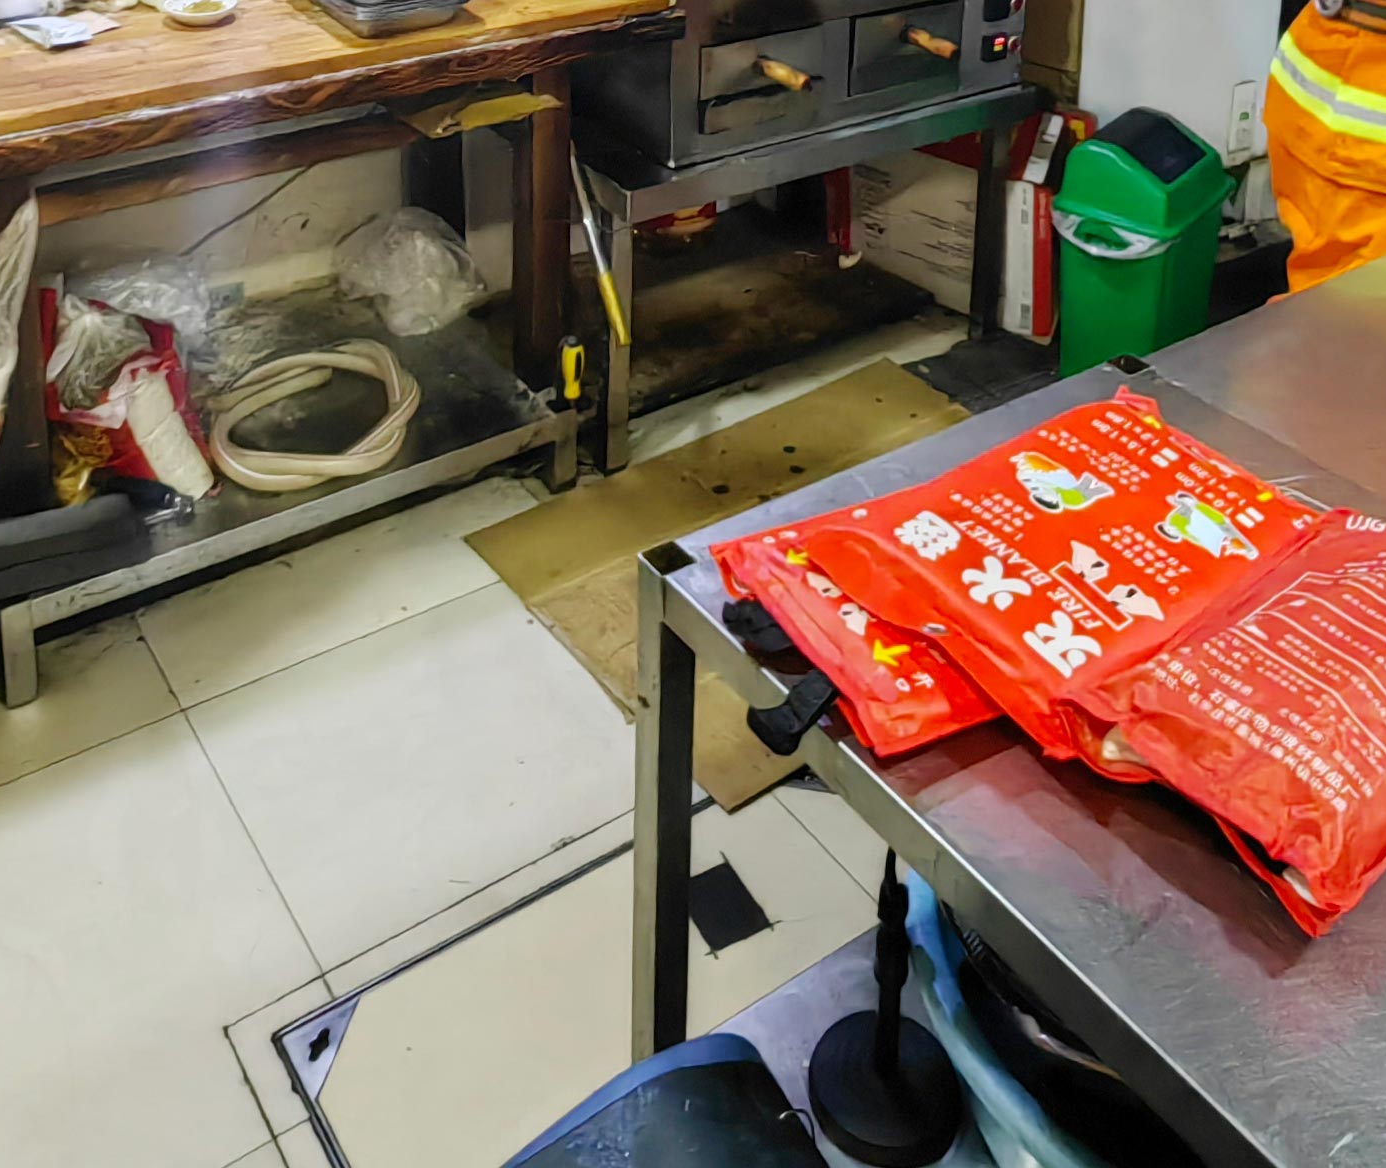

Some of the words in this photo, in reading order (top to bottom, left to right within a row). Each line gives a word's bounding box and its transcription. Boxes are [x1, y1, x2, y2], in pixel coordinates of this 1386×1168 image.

[952, 519, 1052, 587] BLANKET
[893, 510, 1103, 680] 灭火毯
[1048, 584, 1104, 631] FIRE
